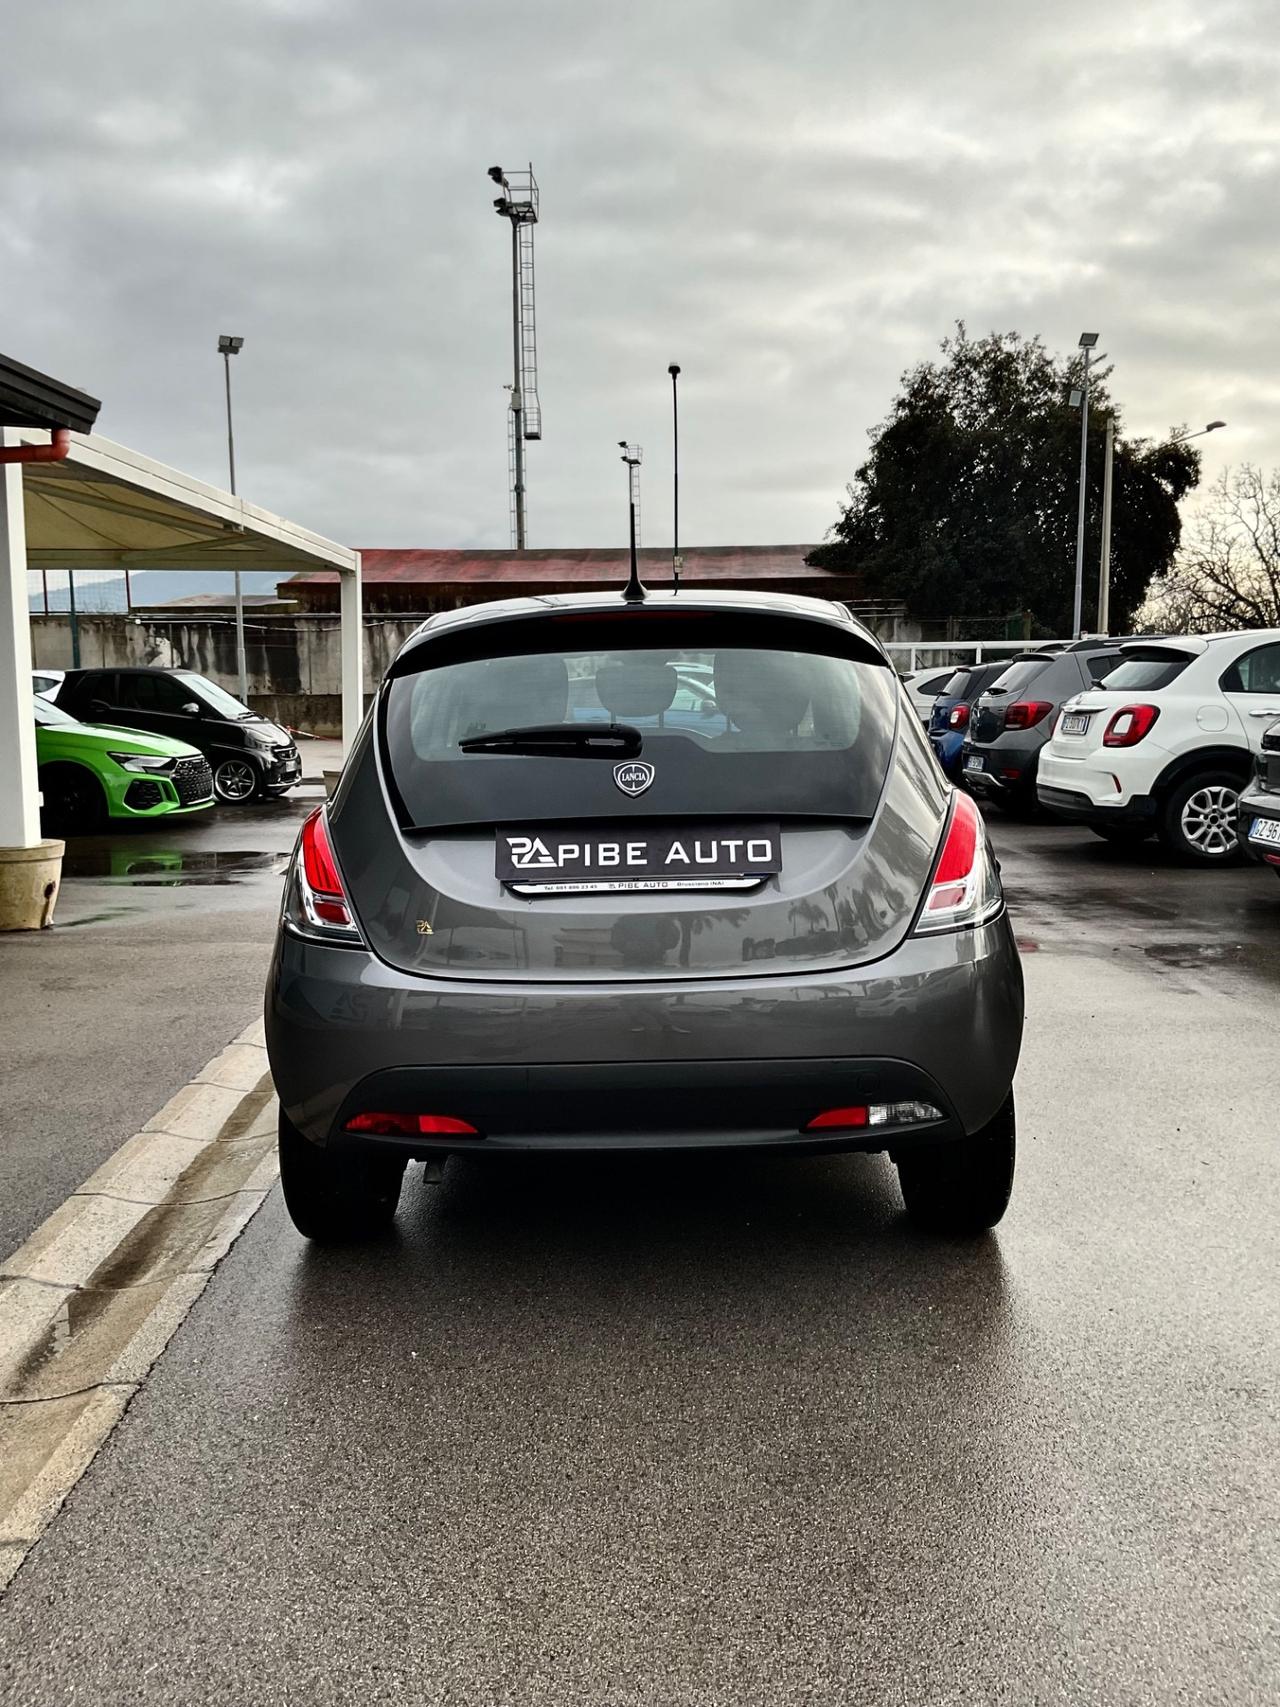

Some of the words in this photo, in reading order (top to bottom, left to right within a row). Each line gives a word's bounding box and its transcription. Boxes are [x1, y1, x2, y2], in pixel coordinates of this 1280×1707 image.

[621, 772, 647, 782] LANCIA
[558, 843, 648, 867] PIBE
[664, 839, 772, 864] AUTO
